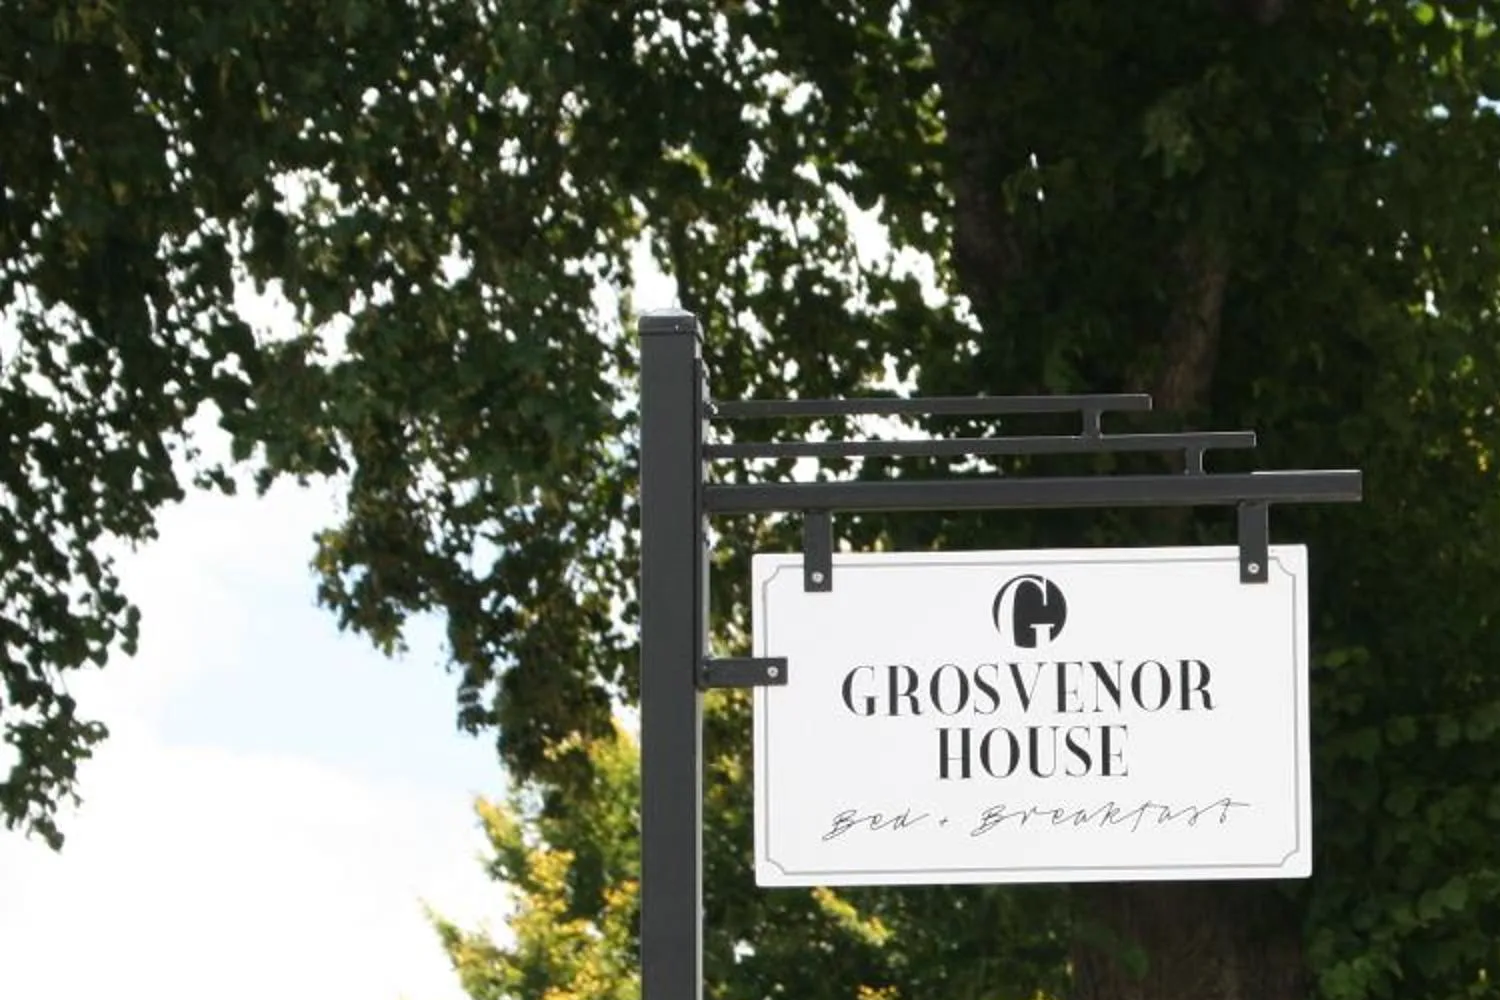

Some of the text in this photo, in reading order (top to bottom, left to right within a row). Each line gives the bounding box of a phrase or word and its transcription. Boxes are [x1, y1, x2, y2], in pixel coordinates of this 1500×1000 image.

[841, 659, 1216, 717] GROSVENOR
[936, 724, 1129, 780] HOUSE
[821, 807, 931, 842] Bed
[969, 796, 1251, 839] Breakfast
